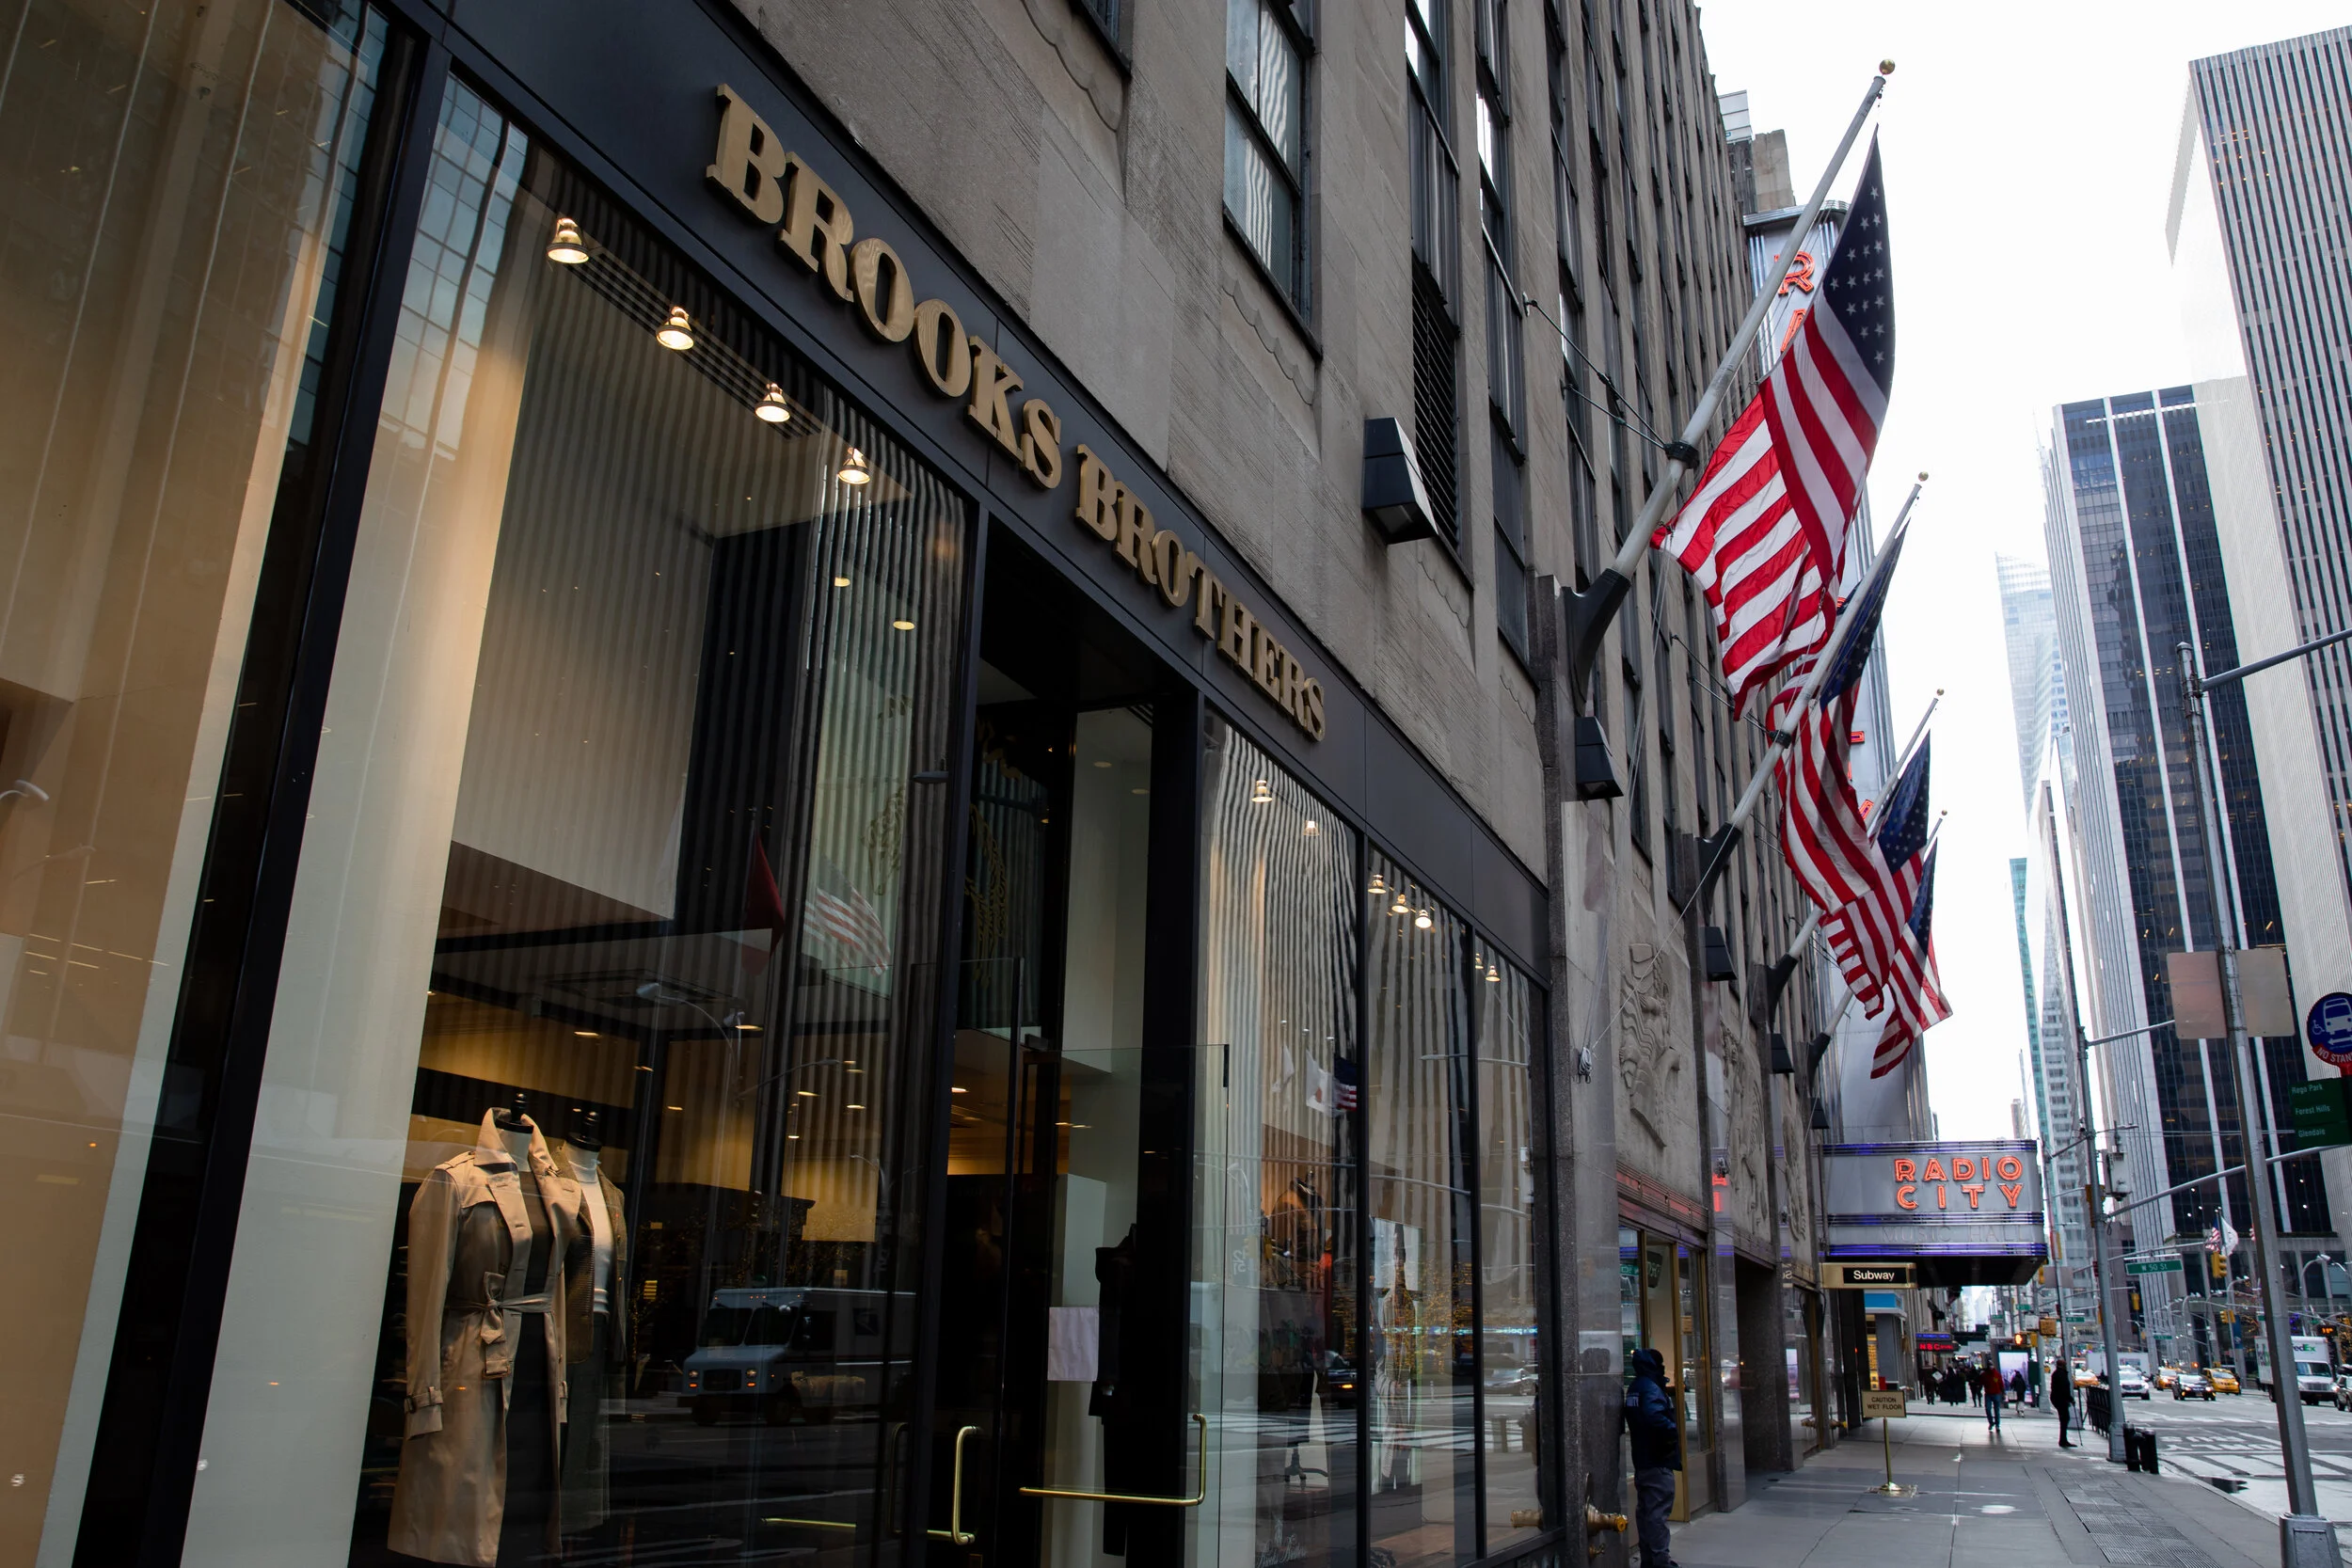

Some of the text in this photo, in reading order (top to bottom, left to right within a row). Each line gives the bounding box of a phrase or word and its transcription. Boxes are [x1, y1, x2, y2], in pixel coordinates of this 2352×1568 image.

[706, 83, 1326, 742] BROOKS BROTHERS
[2316, 1047, 2329, 1059] NO
[2308, 1083, 2324, 1092] Park
[2296, 1104, 2330, 1115] Forest Hills
[2297, 1129, 2326, 1137] Glendale
[1894, 1155, 2023, 1182] RADIO
[1896, 1183, 2024, 1211] CITY
[1882, 1226, 2034, 1243] MUSIC HALL
[1853, 1270, 1895, 1282] Subway
